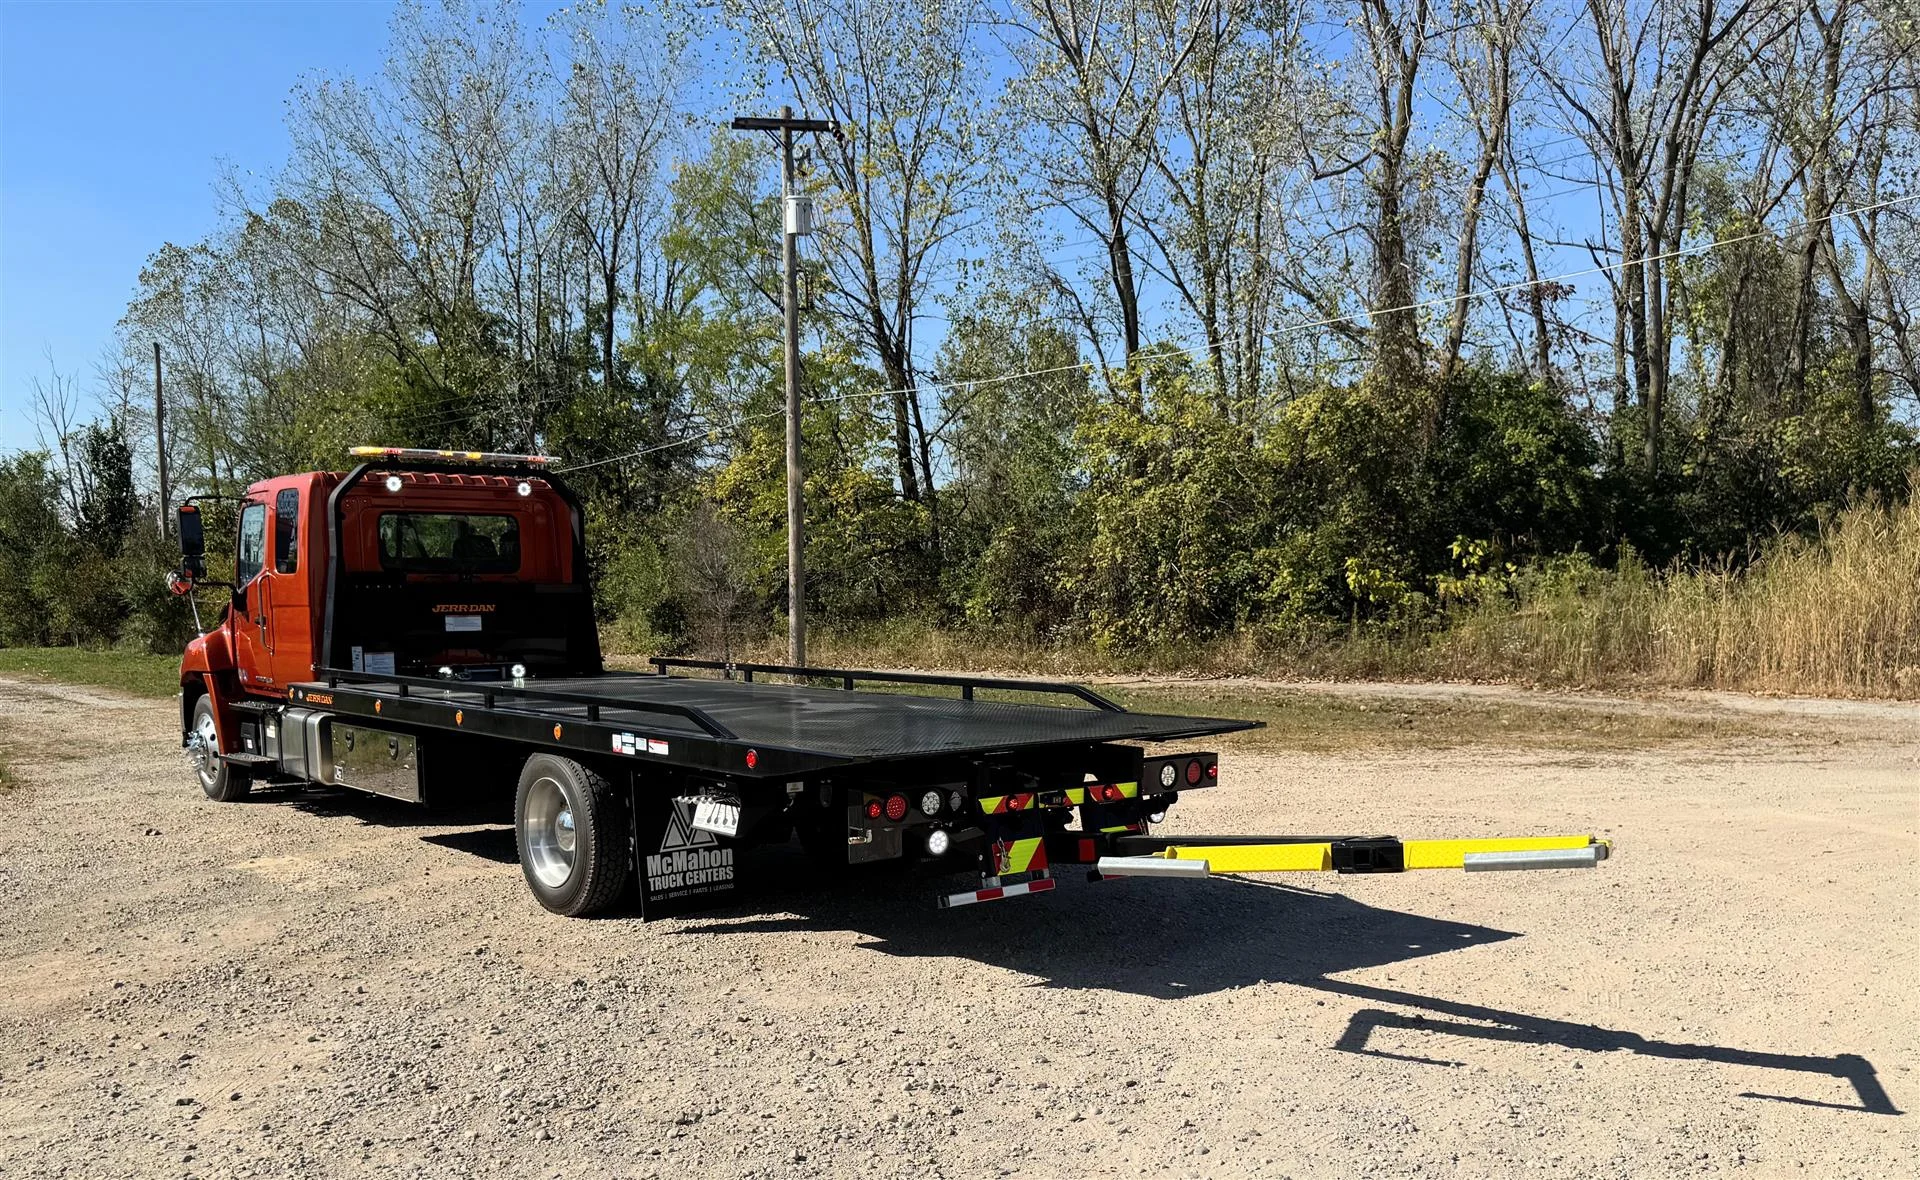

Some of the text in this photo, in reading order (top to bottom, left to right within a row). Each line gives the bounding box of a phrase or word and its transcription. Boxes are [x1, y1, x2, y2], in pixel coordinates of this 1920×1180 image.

[646, 848, 734, 877] McMahon
[648, 866, 734, 892] TRUCK CENTERS
[668, 889, 688, 899] SERVICE
[713, 883, 734, 892] LEASING
